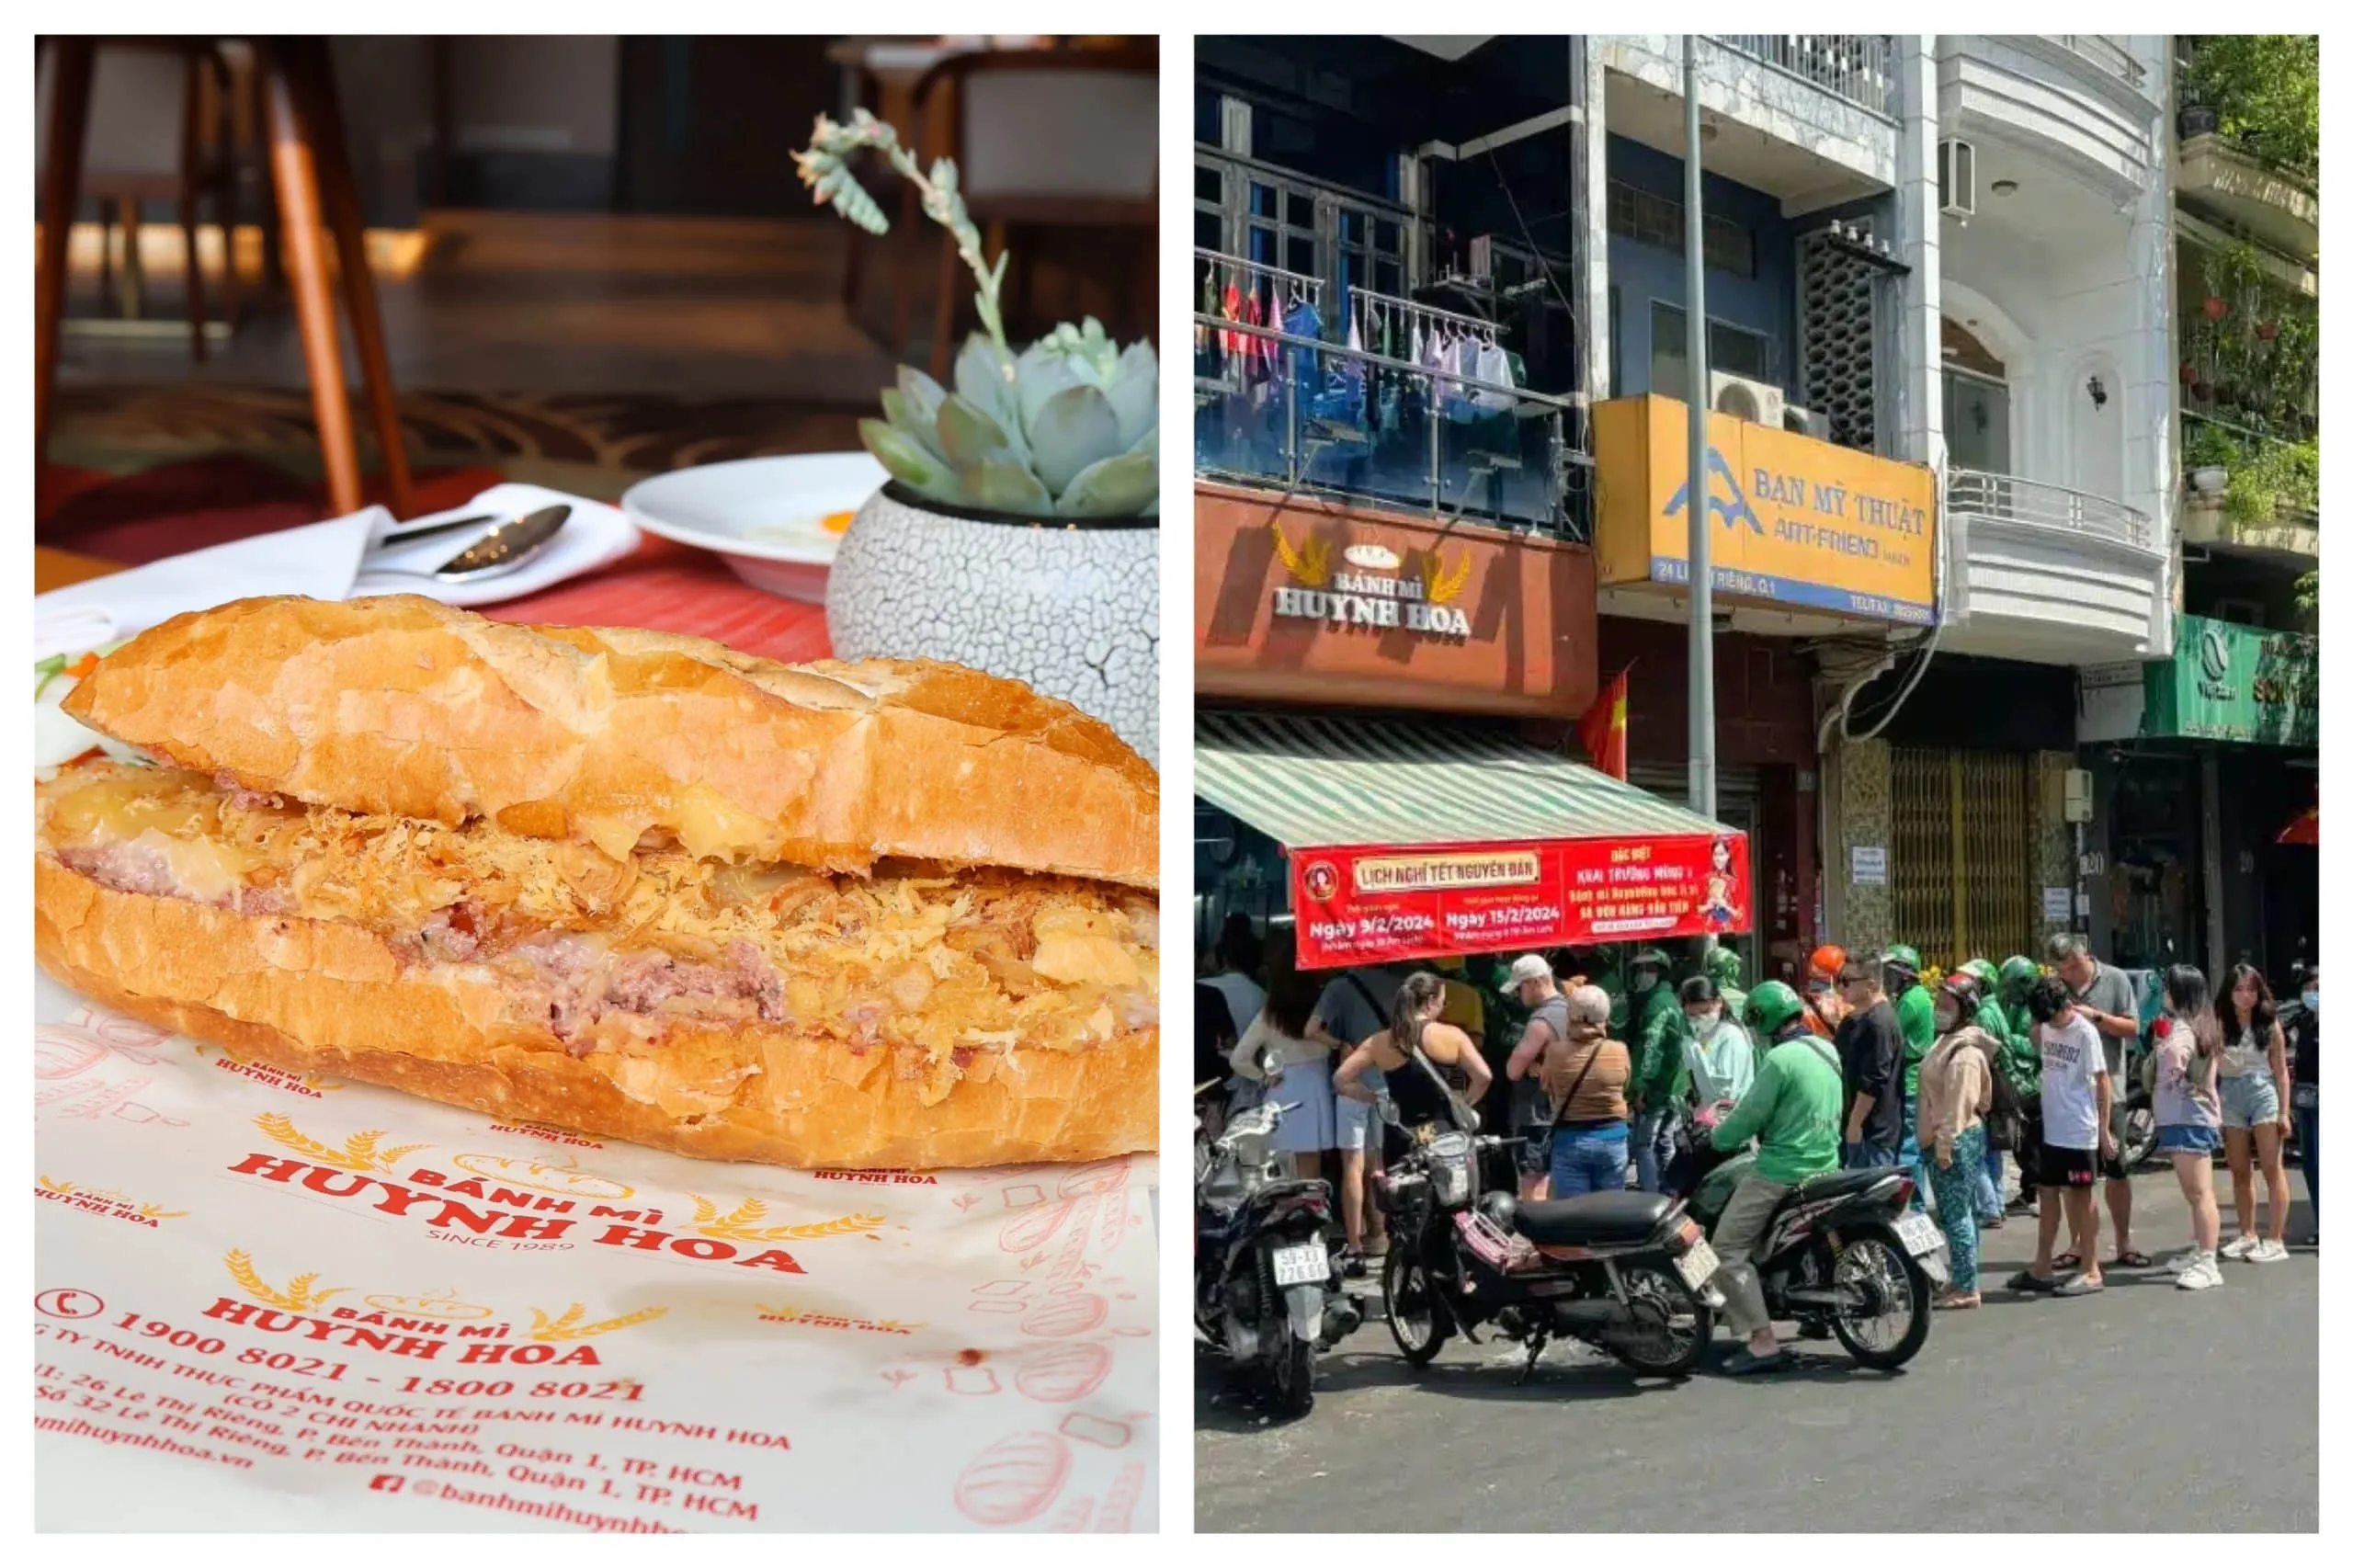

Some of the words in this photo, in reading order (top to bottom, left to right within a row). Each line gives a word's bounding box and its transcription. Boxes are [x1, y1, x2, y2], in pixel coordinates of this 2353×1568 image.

[1754, 468, 1804, 510] BẠN
[1813, 479, 1847, 517] MỸ
[1854, 494, 1926, 540] THUẬT
[1334, 570, 1395, 597] BÁNH
[1398, 575, 1423, 599] MÌ
[1406, 603, 1471, 636] HOA
[1362, 866, 1392, 885] LỊCH
[1395, 861, 1428, 883] NGHỈ
[1431, 860, 1454, 882] TẾT
[1457, 858, 1506, 881] NGUYÊN
[1508, 858, 1533, 878] ĐÁN
[1310, 920, 1356, 939] Ngày
[1360, 914, 1435, 934] 9/2/2024
[1446, 911, 1486, 929] Ngày
[1490, 905, 1560, 926] 15/2/2024
[215, 1058, 282, 1086] HUYNH
[284, 1081, 323, 1098] HOA
[252, 1062, 285, 1076] BÁNH
[563, 1138, 604, 1149] HOA
[814, 1171, 888, 1183] HUYNH
[893, 1175, 938, 1185] HOA
[407, 1168, 576, 1213] BÁNH
[588, 1205, 666, 1225] MÌ
[111, 1210, 159, 1228] HOA
[227, 1153, 577, 1240] HUYNH
[593, 1224, 809, 1274] HOA
[426, 1230, 504, 1249] SINCE
[510, 1242, 575, 1251] 1989
[201, 1297, 449, 1359] HUYNH
[456, 1344, 603, 1366] HOA
[331, 1306, 450, 1335] BÁNH
[458, 1322, 512, 1339] MÌ
[111, 1312, 226, 1355] 1900
[235, 1346, 348, 1382] 8021
[396, 1376, 515, 1397] 1800
[529, 1380, 645, 1403] 8021
[55, 1328, 91, 1345] TY
[92, 1338, 167, 1370] TNHH
[726, 1429, 792, 1451] HOA
[70, 1374, 109, 1392] 26
[296, 1426, 319, 1442] P.
[621, 1457, 658, 1478] TP.
[667, 1464, 744, 1492] HCM
[279, 1405, 301, 1418] 2
[308, 1411, 358, 1430] CHI
[74, 1394, 113, 1414] 32
[303, 1448, 326, 1463] P.
[636, 1483, 673, 1506] TP.
[683, 1492, 760, 1522] HCM
